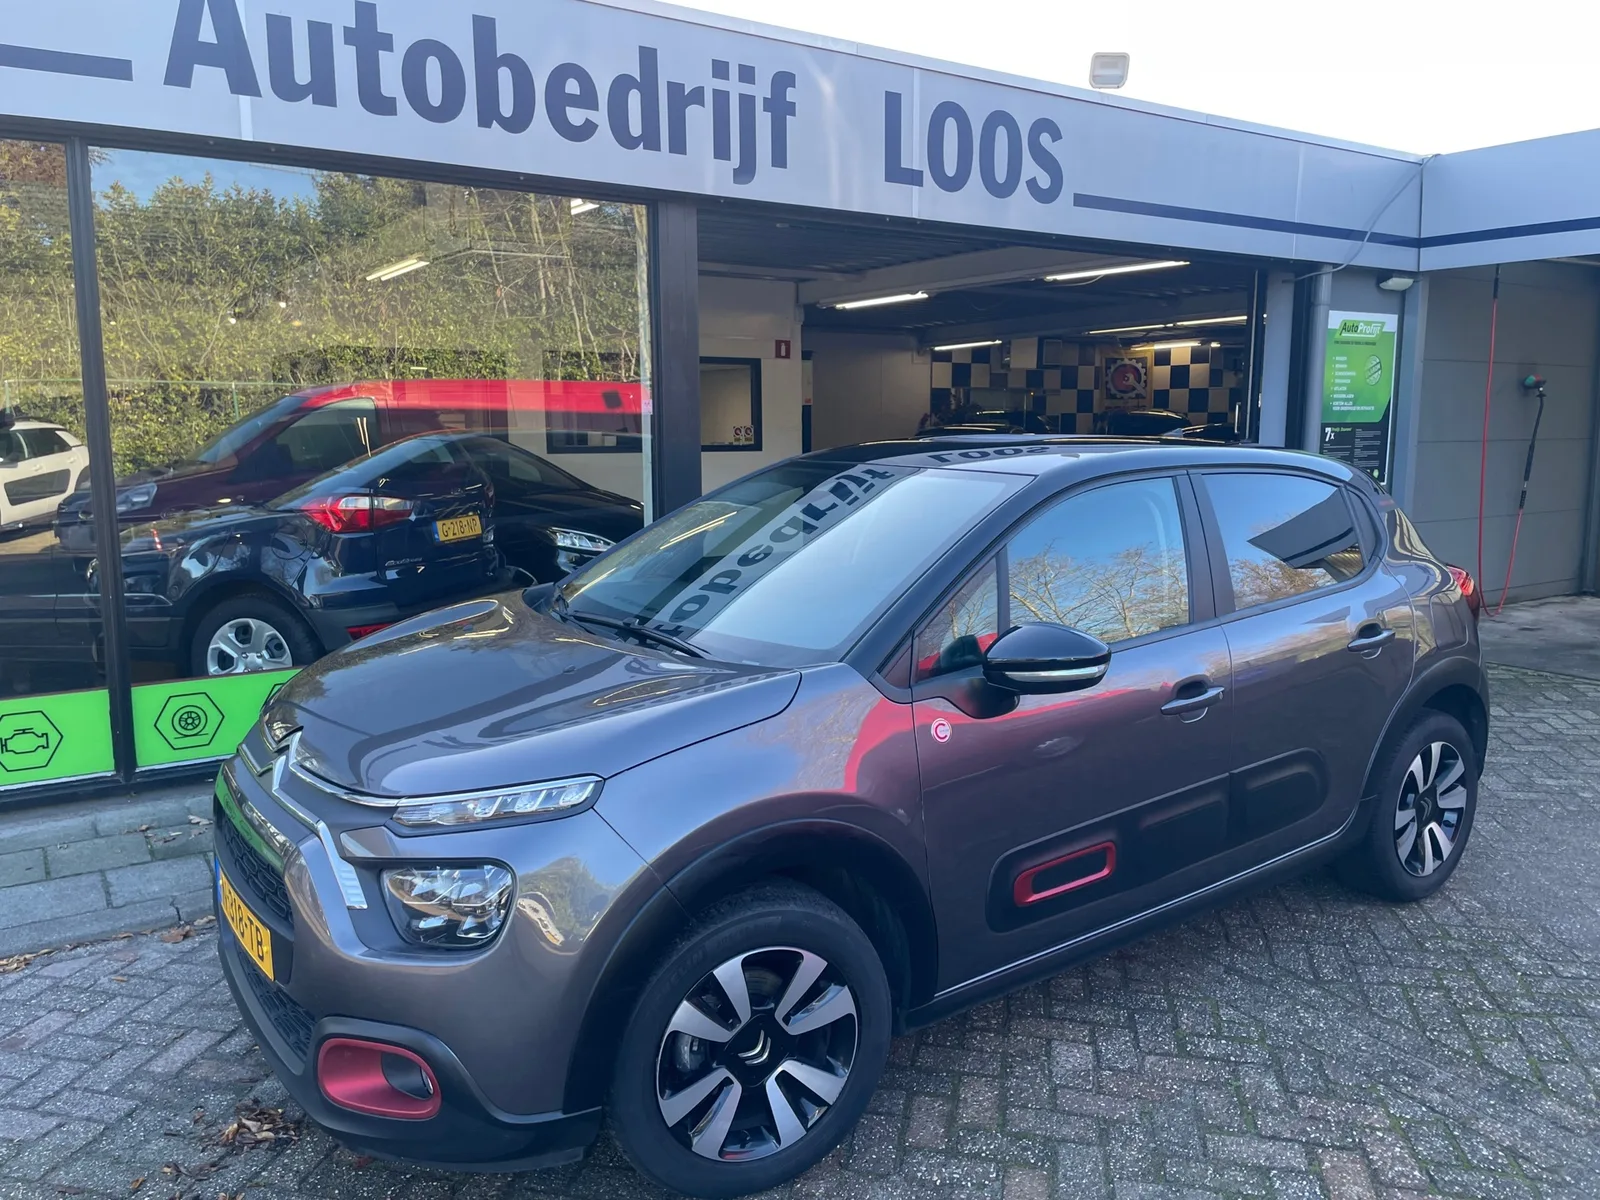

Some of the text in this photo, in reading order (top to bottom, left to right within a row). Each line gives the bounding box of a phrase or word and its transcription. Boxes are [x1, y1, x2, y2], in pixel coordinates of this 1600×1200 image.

[163, 0, 1064, 205] Autobedrijf LOOS
[441, 518, 478, 538] G-218-NP
